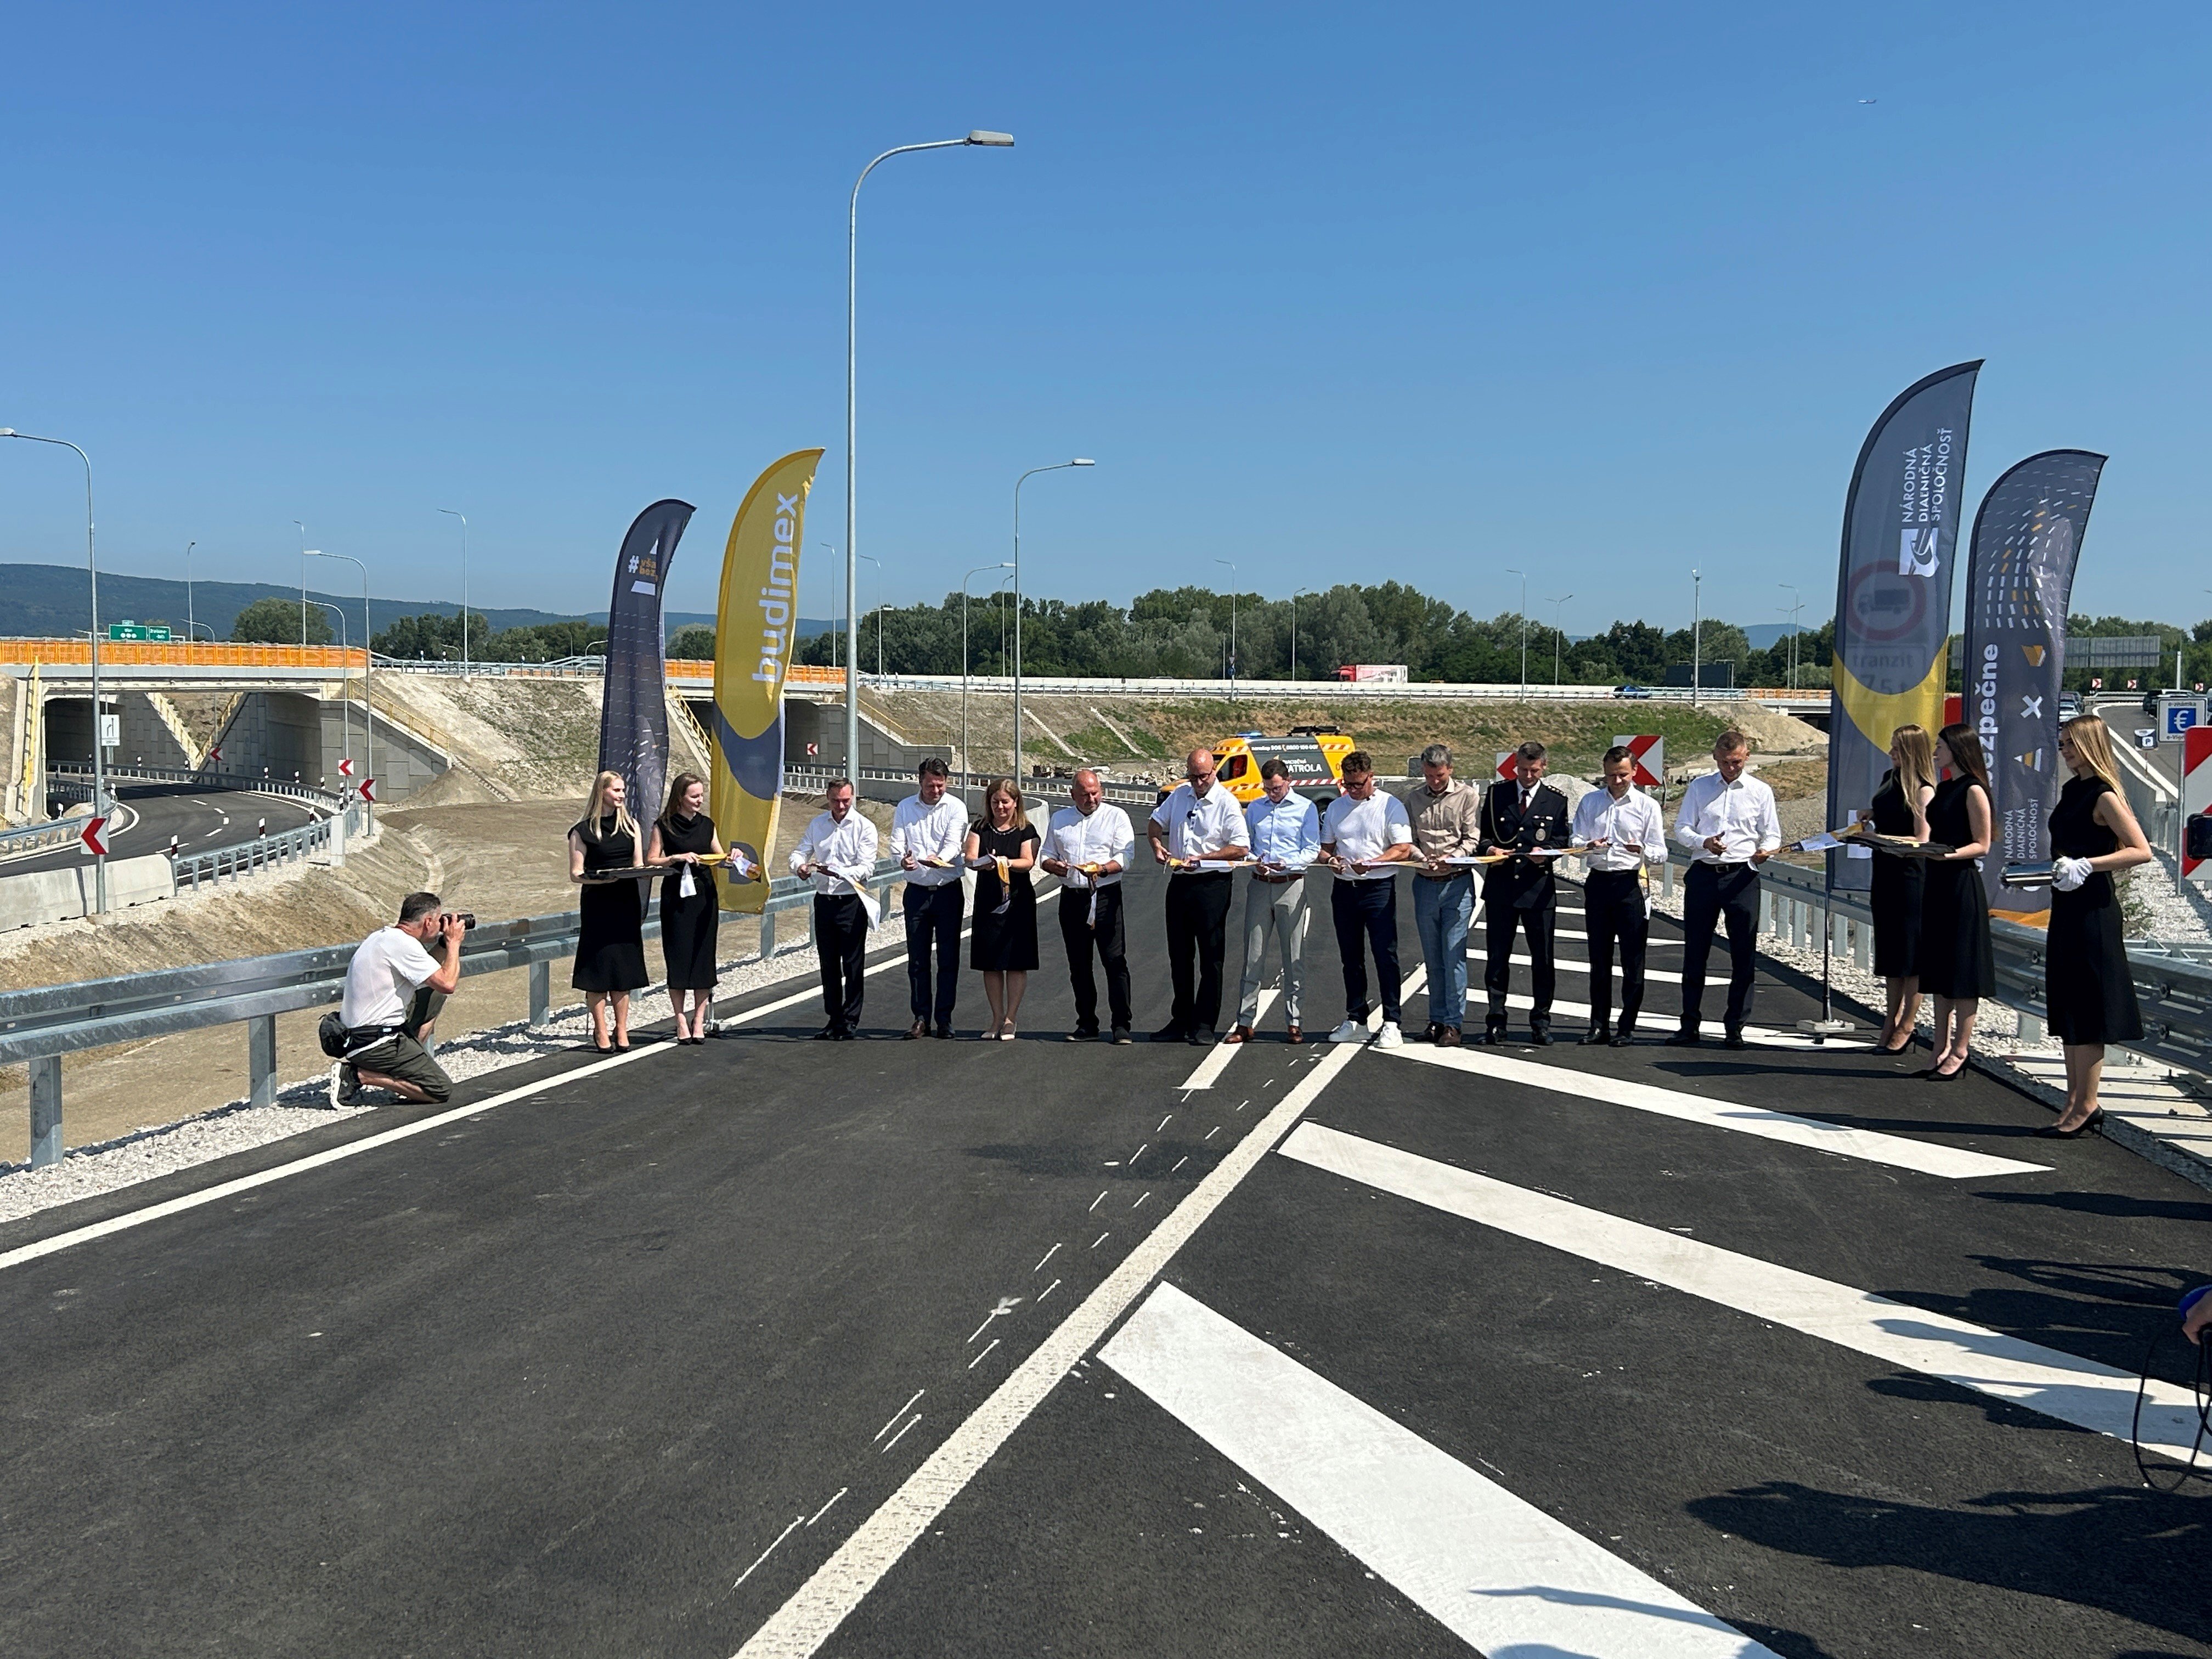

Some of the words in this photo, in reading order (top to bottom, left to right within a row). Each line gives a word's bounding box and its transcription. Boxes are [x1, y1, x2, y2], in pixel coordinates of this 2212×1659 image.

[1900, 448, 1917, 522] NÁRODNÁ
[1918, 443, 1933, 522] DIAĽNIČNÁ
[1931, 428, 1953, 521] SPOLOČNOSŤ
[752, 492, 798, 682] budimex
[1286, 764, 1323, 772] ATROLA
[2003, 810, 2013, 859] NÁRODNÁ
